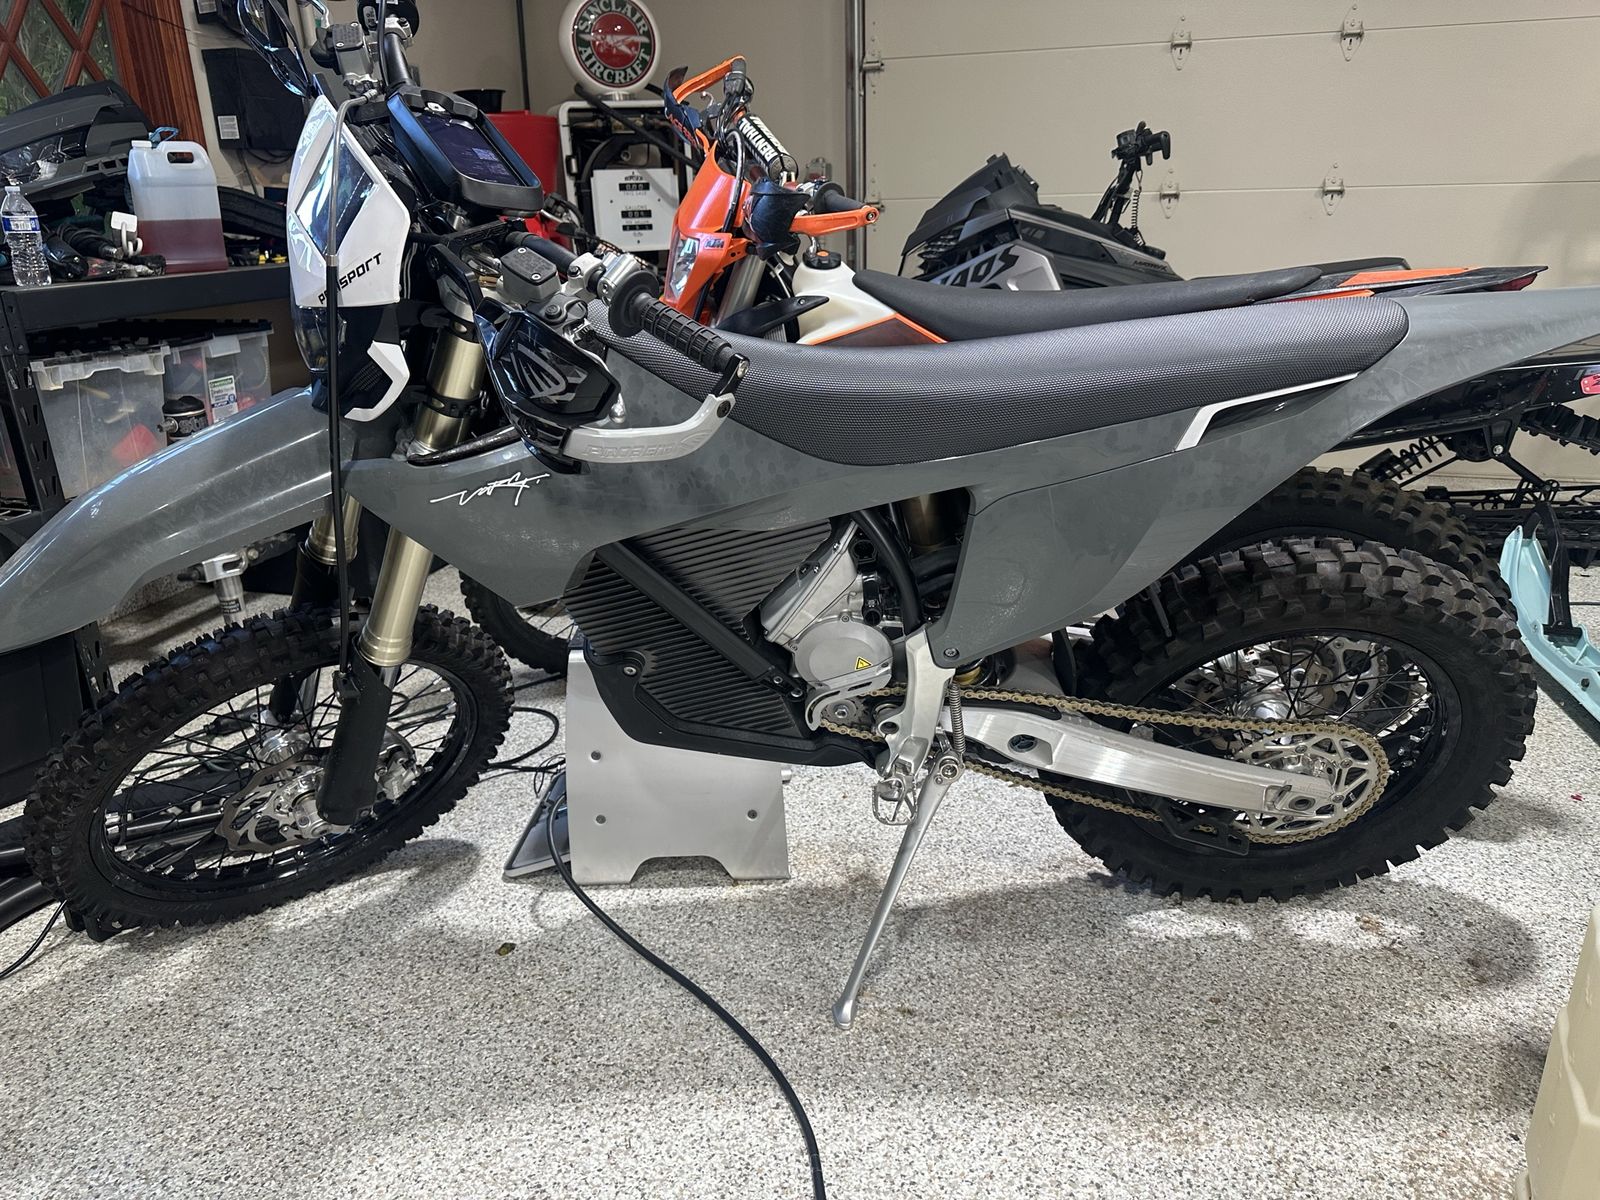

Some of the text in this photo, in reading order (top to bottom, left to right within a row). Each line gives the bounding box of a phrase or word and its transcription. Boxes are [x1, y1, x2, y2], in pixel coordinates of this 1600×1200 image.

[578, 0, 648, 34] SINCLAIR
[578, 46, 651, 83] AIRCRAFT
[739, 117, 778, 162] RENTHAL
